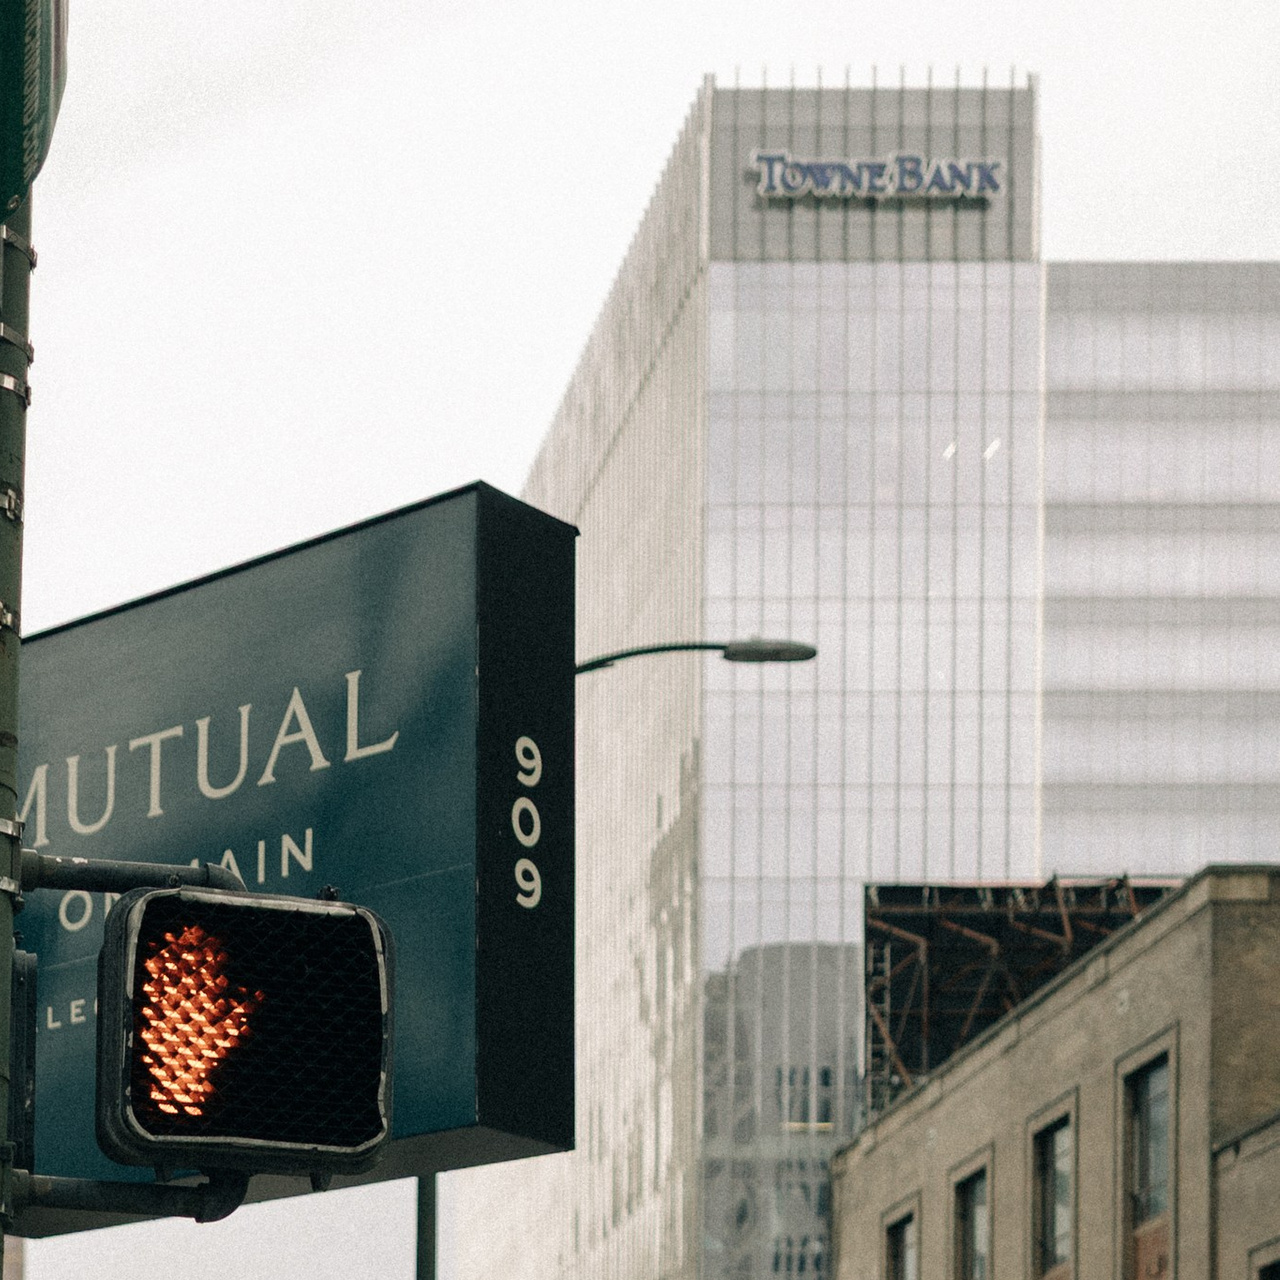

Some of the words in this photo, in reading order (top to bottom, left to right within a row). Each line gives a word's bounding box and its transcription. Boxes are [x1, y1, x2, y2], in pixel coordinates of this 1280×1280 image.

[511, 736, 543, 909] 909
[190, 828, 314, 893] AIN
[46, 997, 98, 1030] LE
